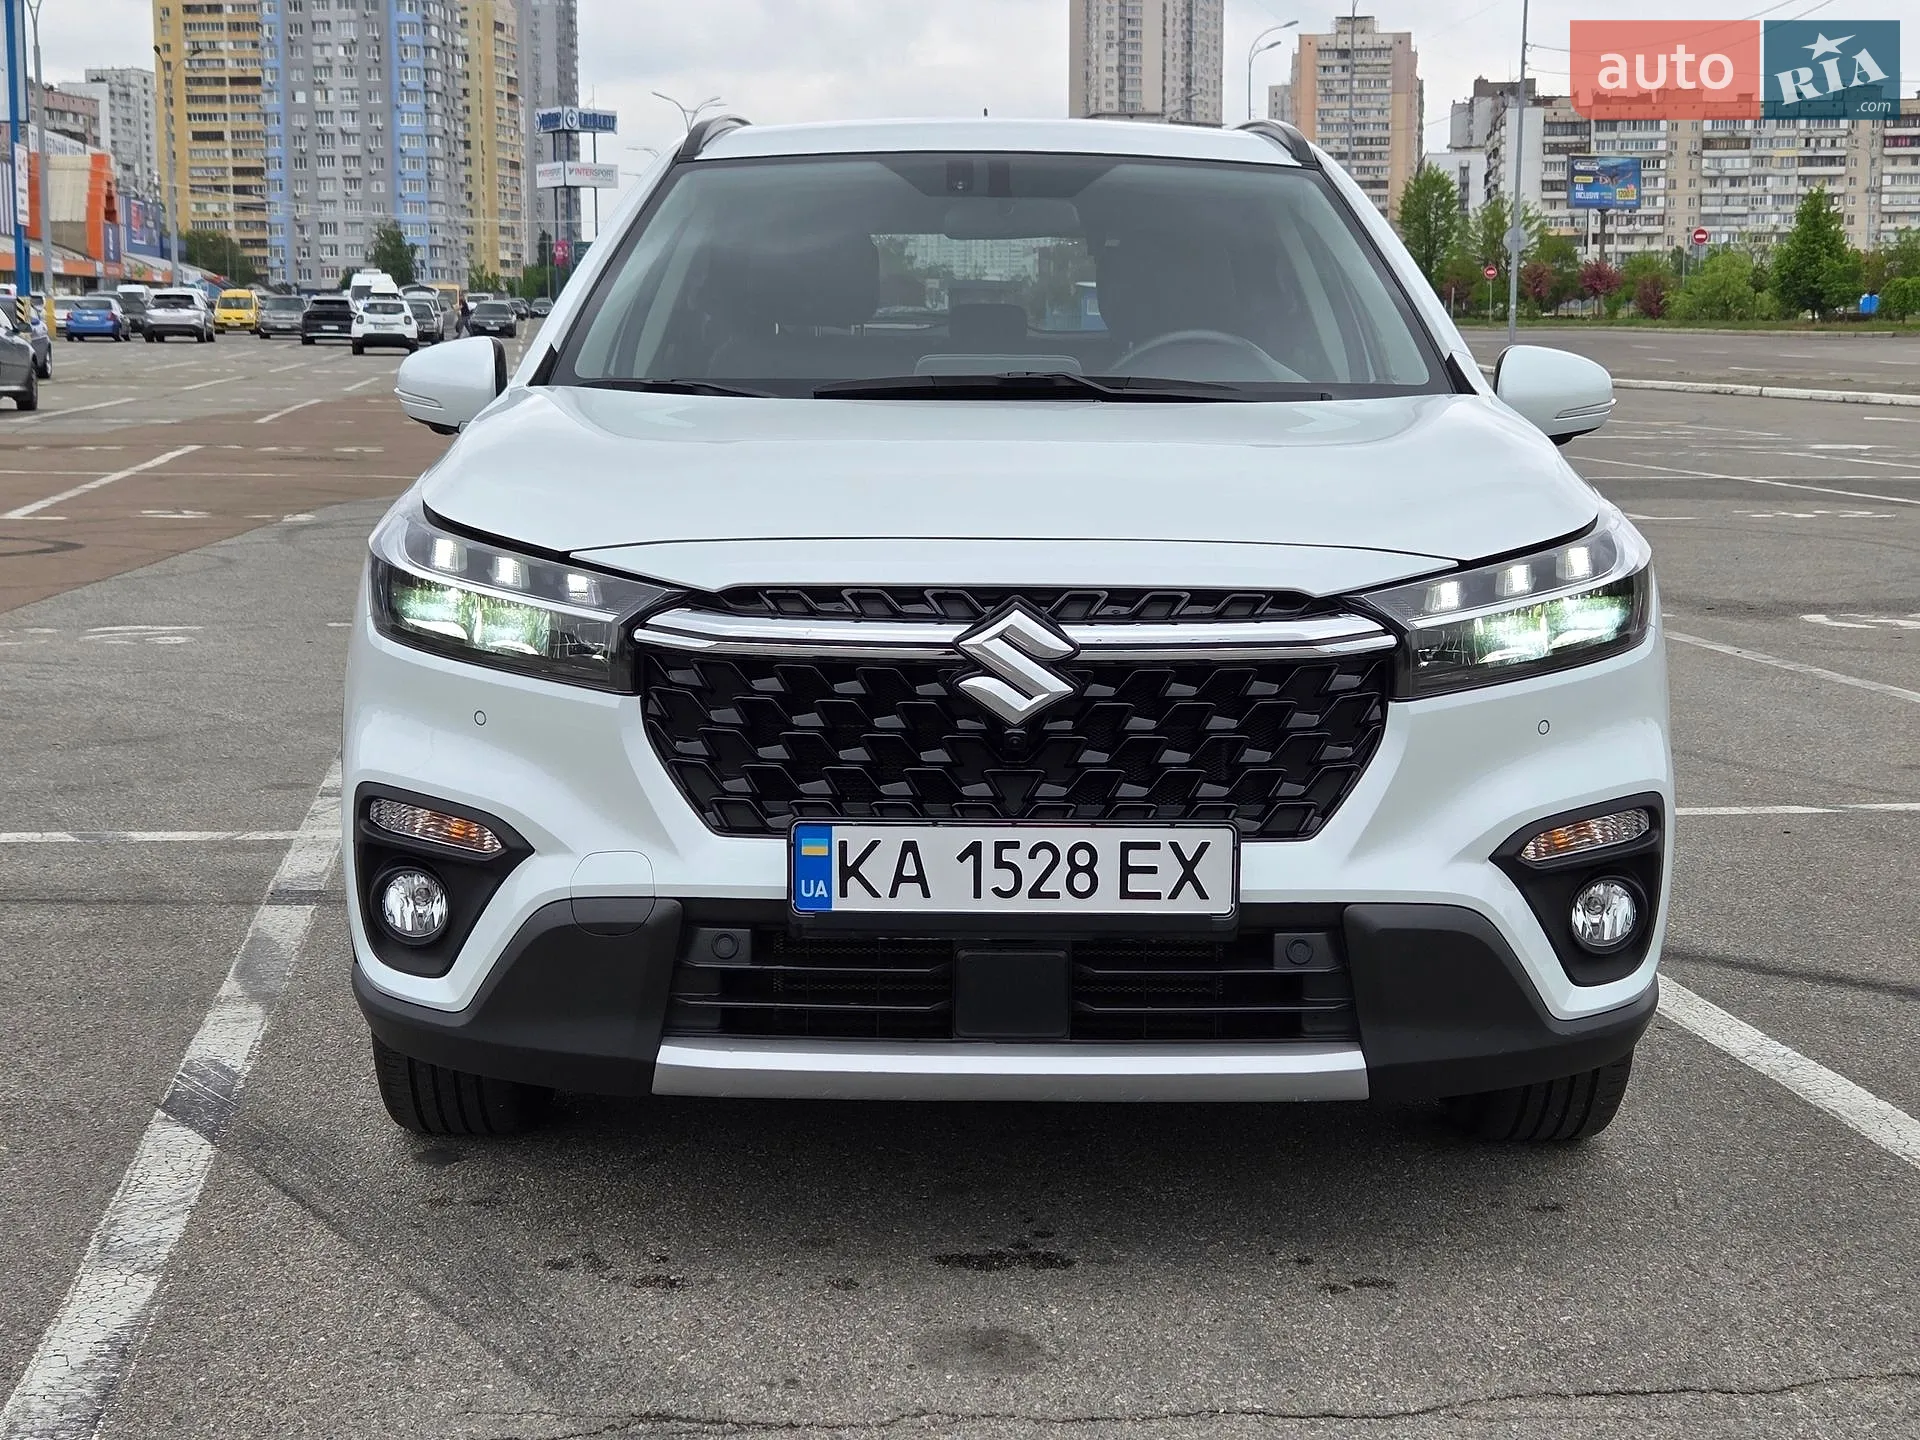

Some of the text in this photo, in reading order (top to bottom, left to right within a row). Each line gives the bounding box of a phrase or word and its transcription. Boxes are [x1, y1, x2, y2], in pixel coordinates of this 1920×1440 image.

[575, 167, 614, 177] INTERSPORT
[838, 839, 1211, 901] KA 1528 EX
[801, 879, 829, 899] UA
